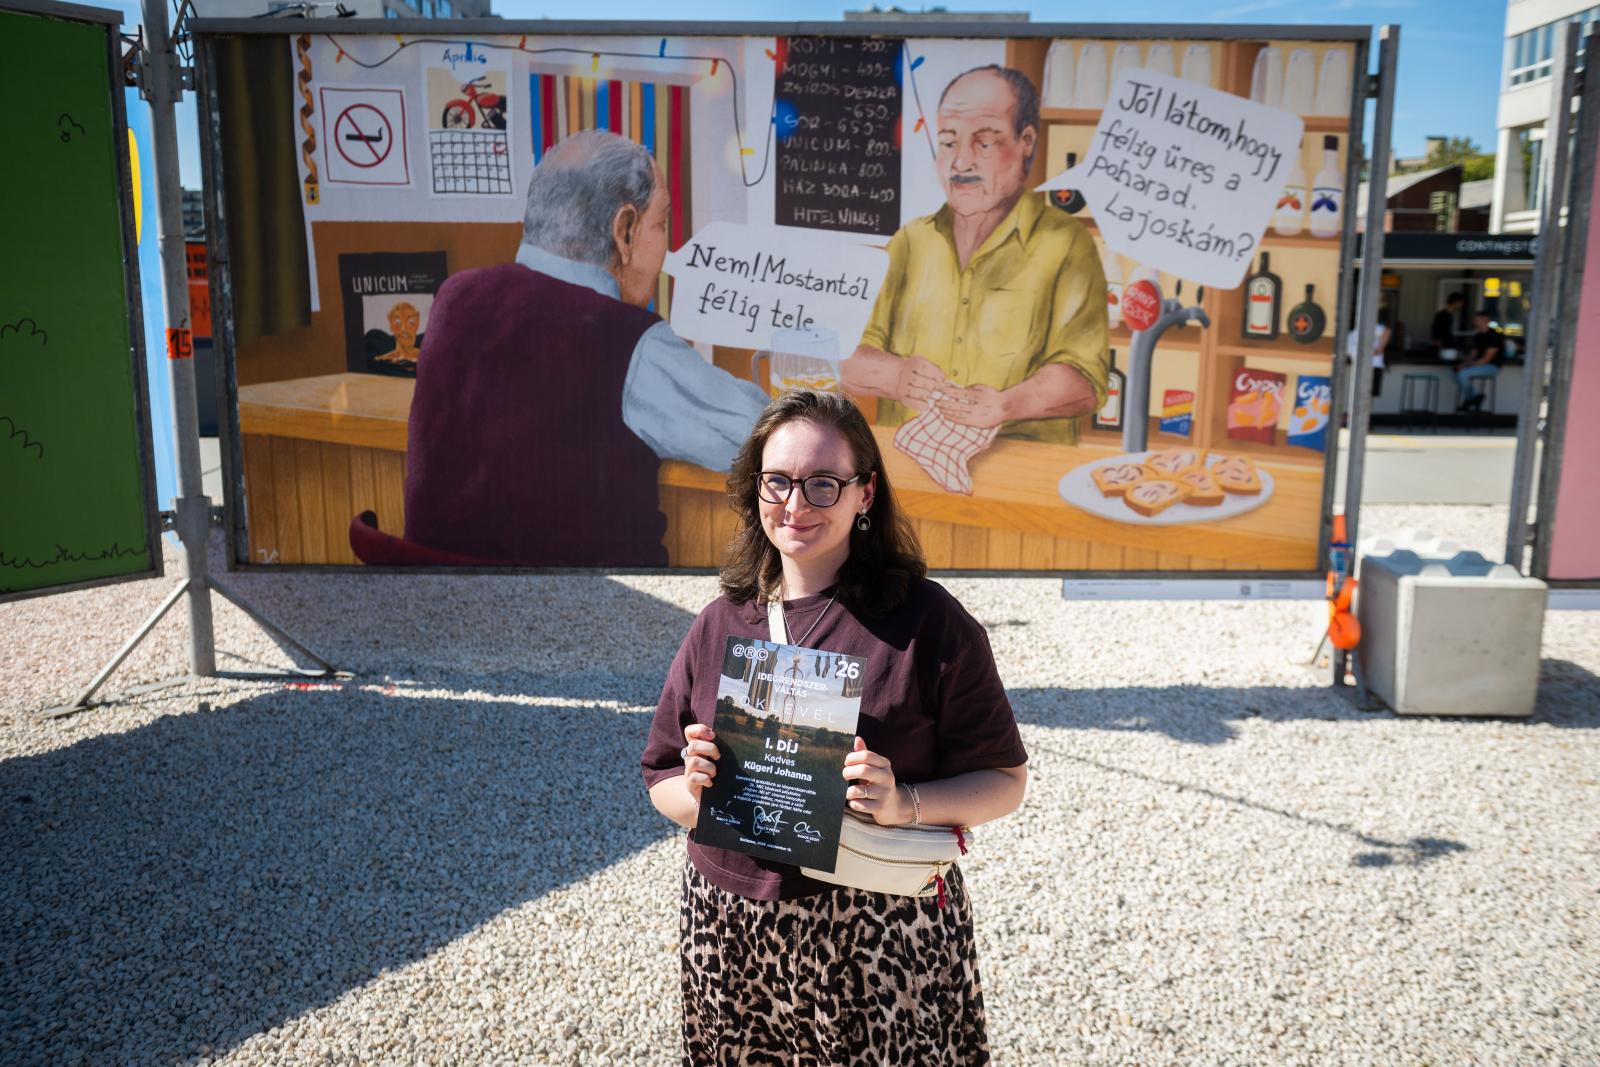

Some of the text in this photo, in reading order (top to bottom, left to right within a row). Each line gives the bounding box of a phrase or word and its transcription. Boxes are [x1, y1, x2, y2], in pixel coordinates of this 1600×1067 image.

[1119, 80, 1162, 118] Jól
[783, 135, 851, 152] UNICUM
[1100, 119, 1156, 170] félig
[1225, 174, 1241, 191] a
[1087, 155, 1196, 210] poharad.
[794, 206, 881, 231] HITEL NINCS!
[1104, 192, 1255, 261] Lajoskám?
[352, 275, 408, 293] UNICUM
[698, 282, 760, 333] félig
[835, 660, 860, 680] 26
[757, 672, 829, 692] IDEGRENDSZER-
[776, 739, 799, 753] DÍJ
[764, 753, 796, 766] Kedves
[744, 760, 813, 782] Kügerl Johanna
